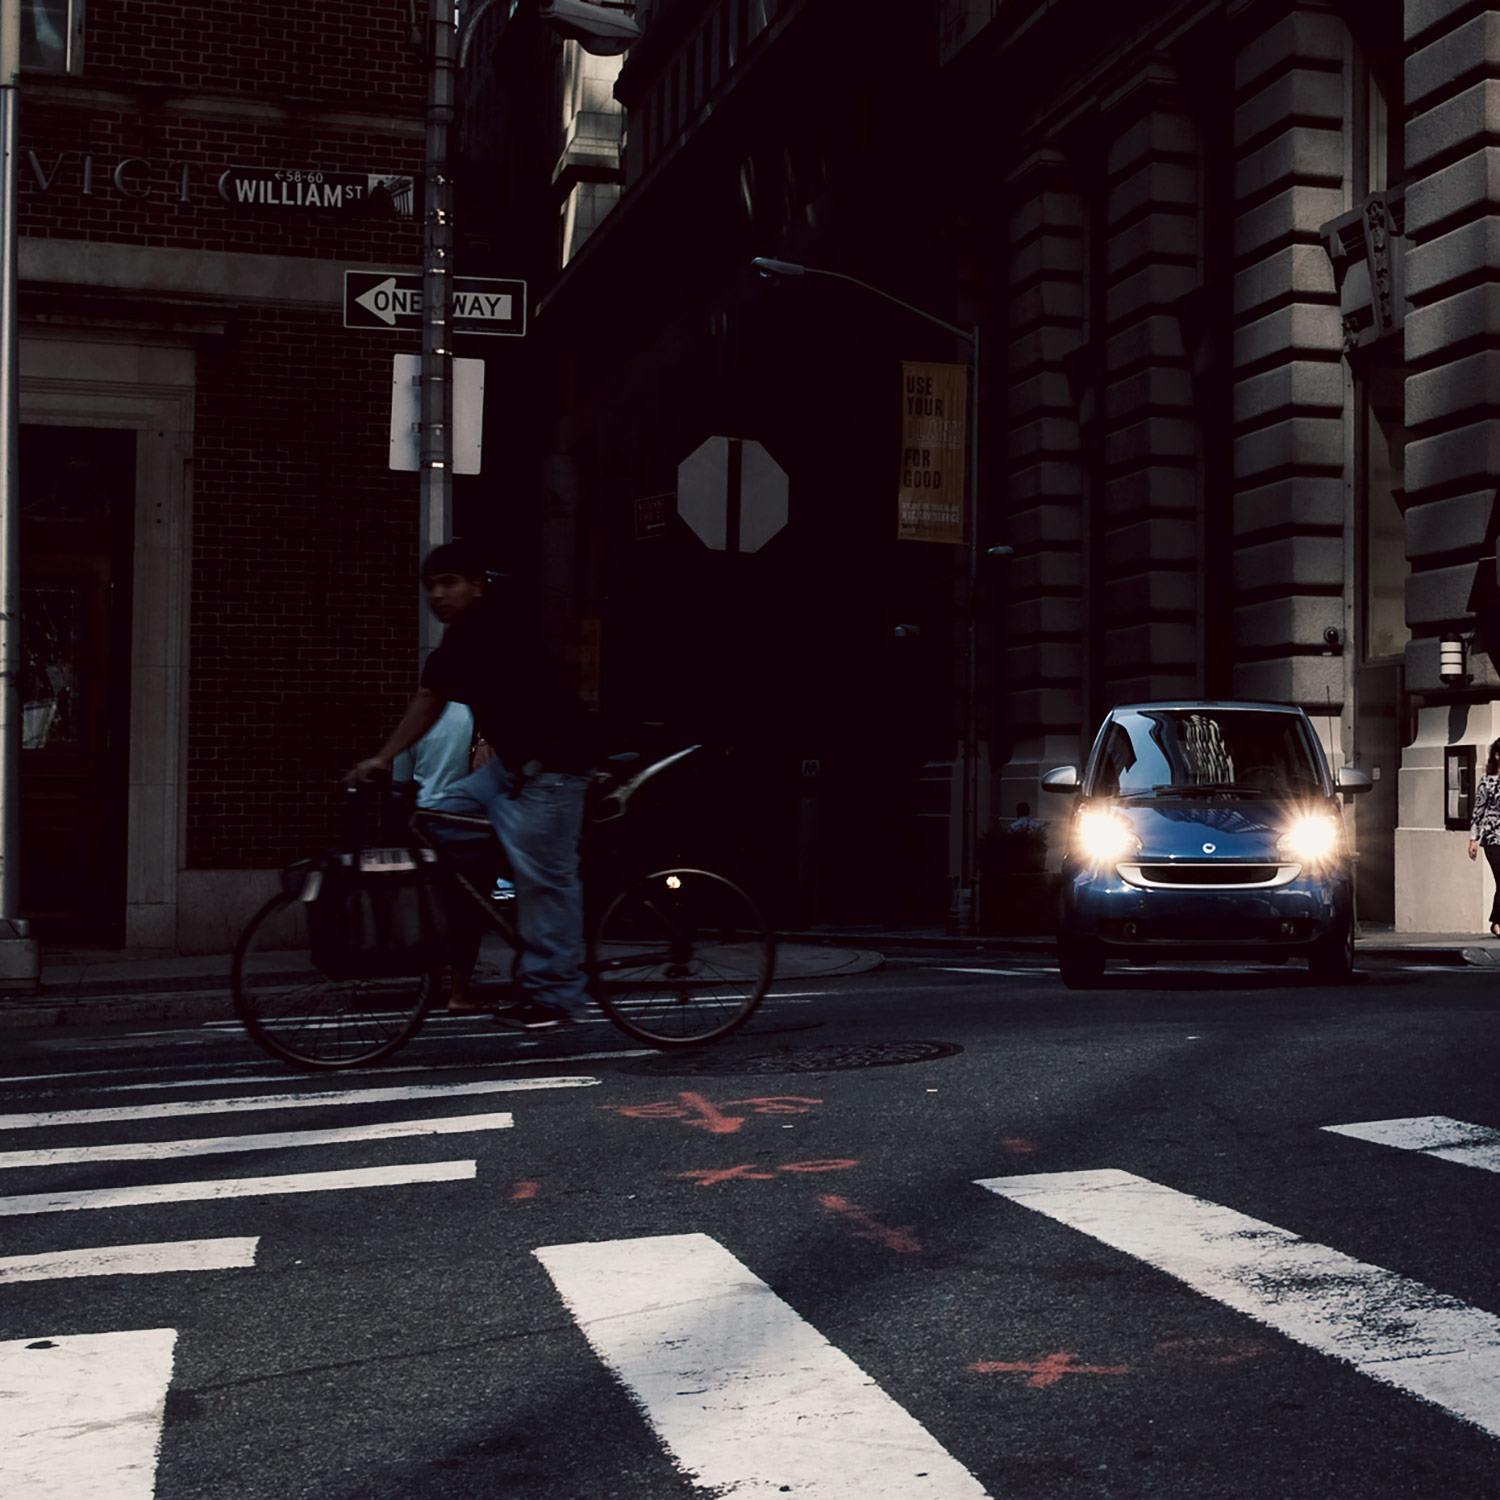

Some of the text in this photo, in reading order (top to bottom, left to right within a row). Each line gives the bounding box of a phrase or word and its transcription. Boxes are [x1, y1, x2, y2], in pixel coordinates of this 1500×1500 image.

[286, 170, 324, 185] 58-60
[235, 178, 364, 208] WILLIAM ST
[374, 290, 502, 317] ONE WAY
[906, 375, 933, 396] USE
[906, 397, 943, 417] YOUR
[903, 447, 931, 468] FOR
[903, 469, 942, 490] GOOD
